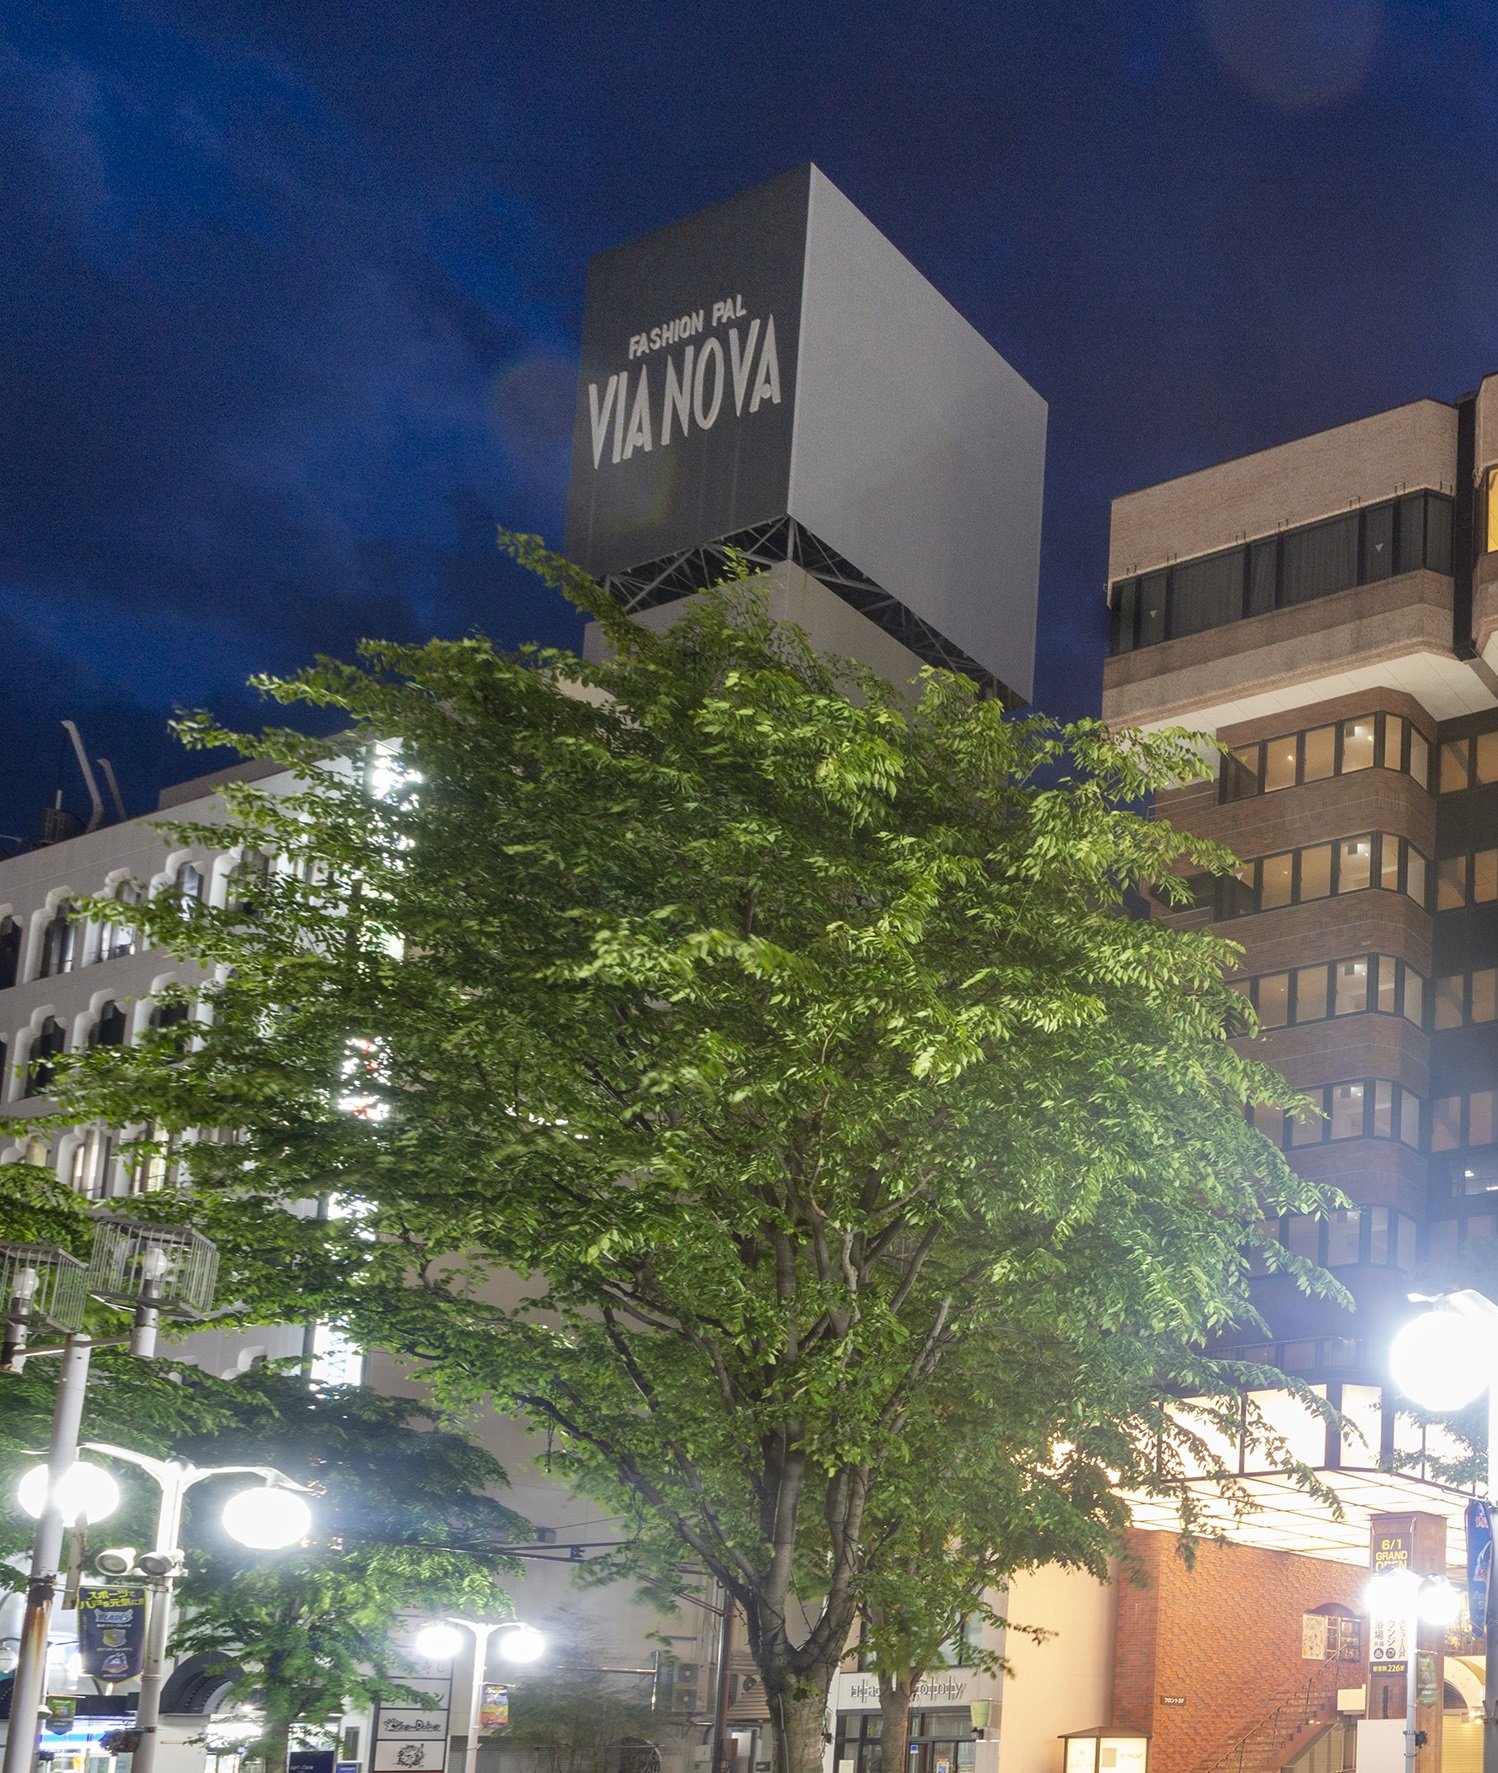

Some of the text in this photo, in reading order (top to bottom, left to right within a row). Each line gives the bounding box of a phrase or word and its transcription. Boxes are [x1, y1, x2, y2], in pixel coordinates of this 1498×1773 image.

[628, 294, 747, 360] FASHION PAL
[588, 313, 781, 470] VIA NOVA
[1376, 1550, 1408, 1561] GRAND
[1382, 1539, 1402, 1550] 6/1
